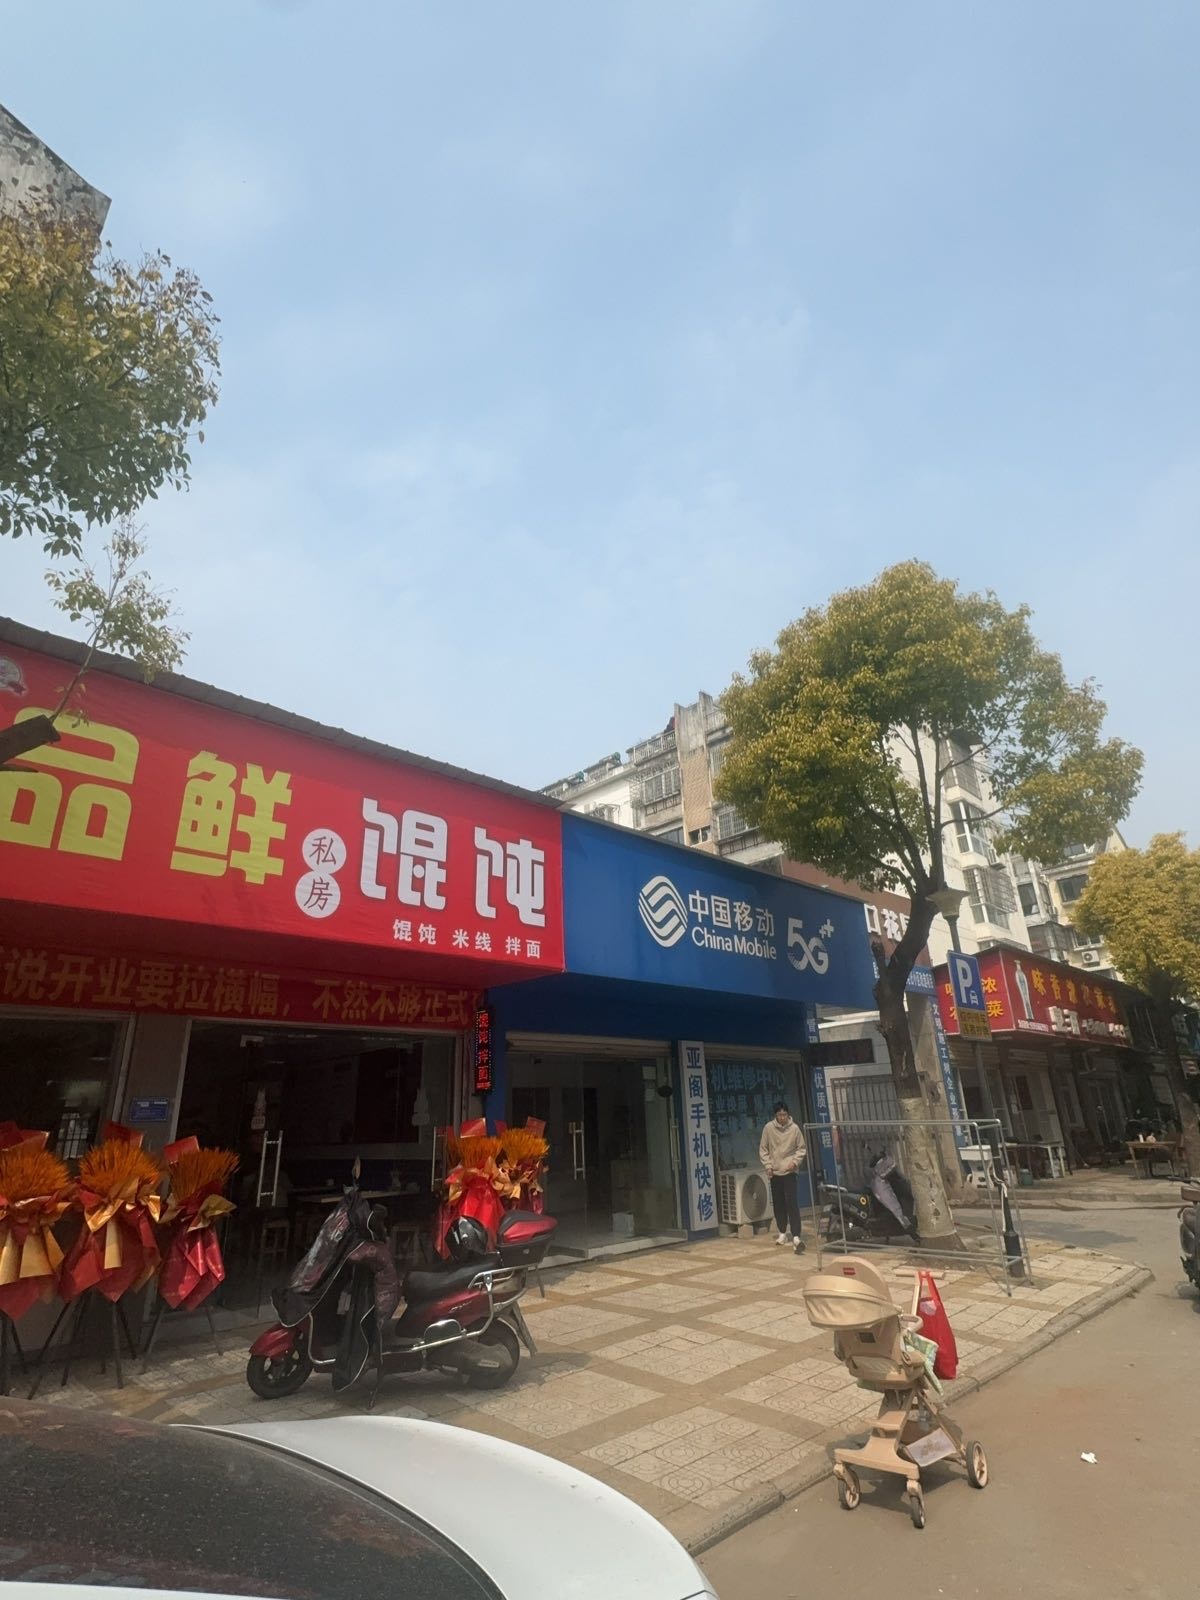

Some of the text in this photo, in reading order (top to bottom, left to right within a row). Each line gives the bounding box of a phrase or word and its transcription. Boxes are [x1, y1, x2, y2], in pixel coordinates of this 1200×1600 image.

[303, 835, 338, 912] 私房
[359, 797, 547, 928] 馄饨
[687, 889, 775, 937] 中国移动
[392, 918, 542, 959] 馄饨 米线 拌面
[691, 926, 778, 960] China Mobile
[955, 958, 973, 1004] P
[686, 1046, 715, 1222] 亚阁手机快修
